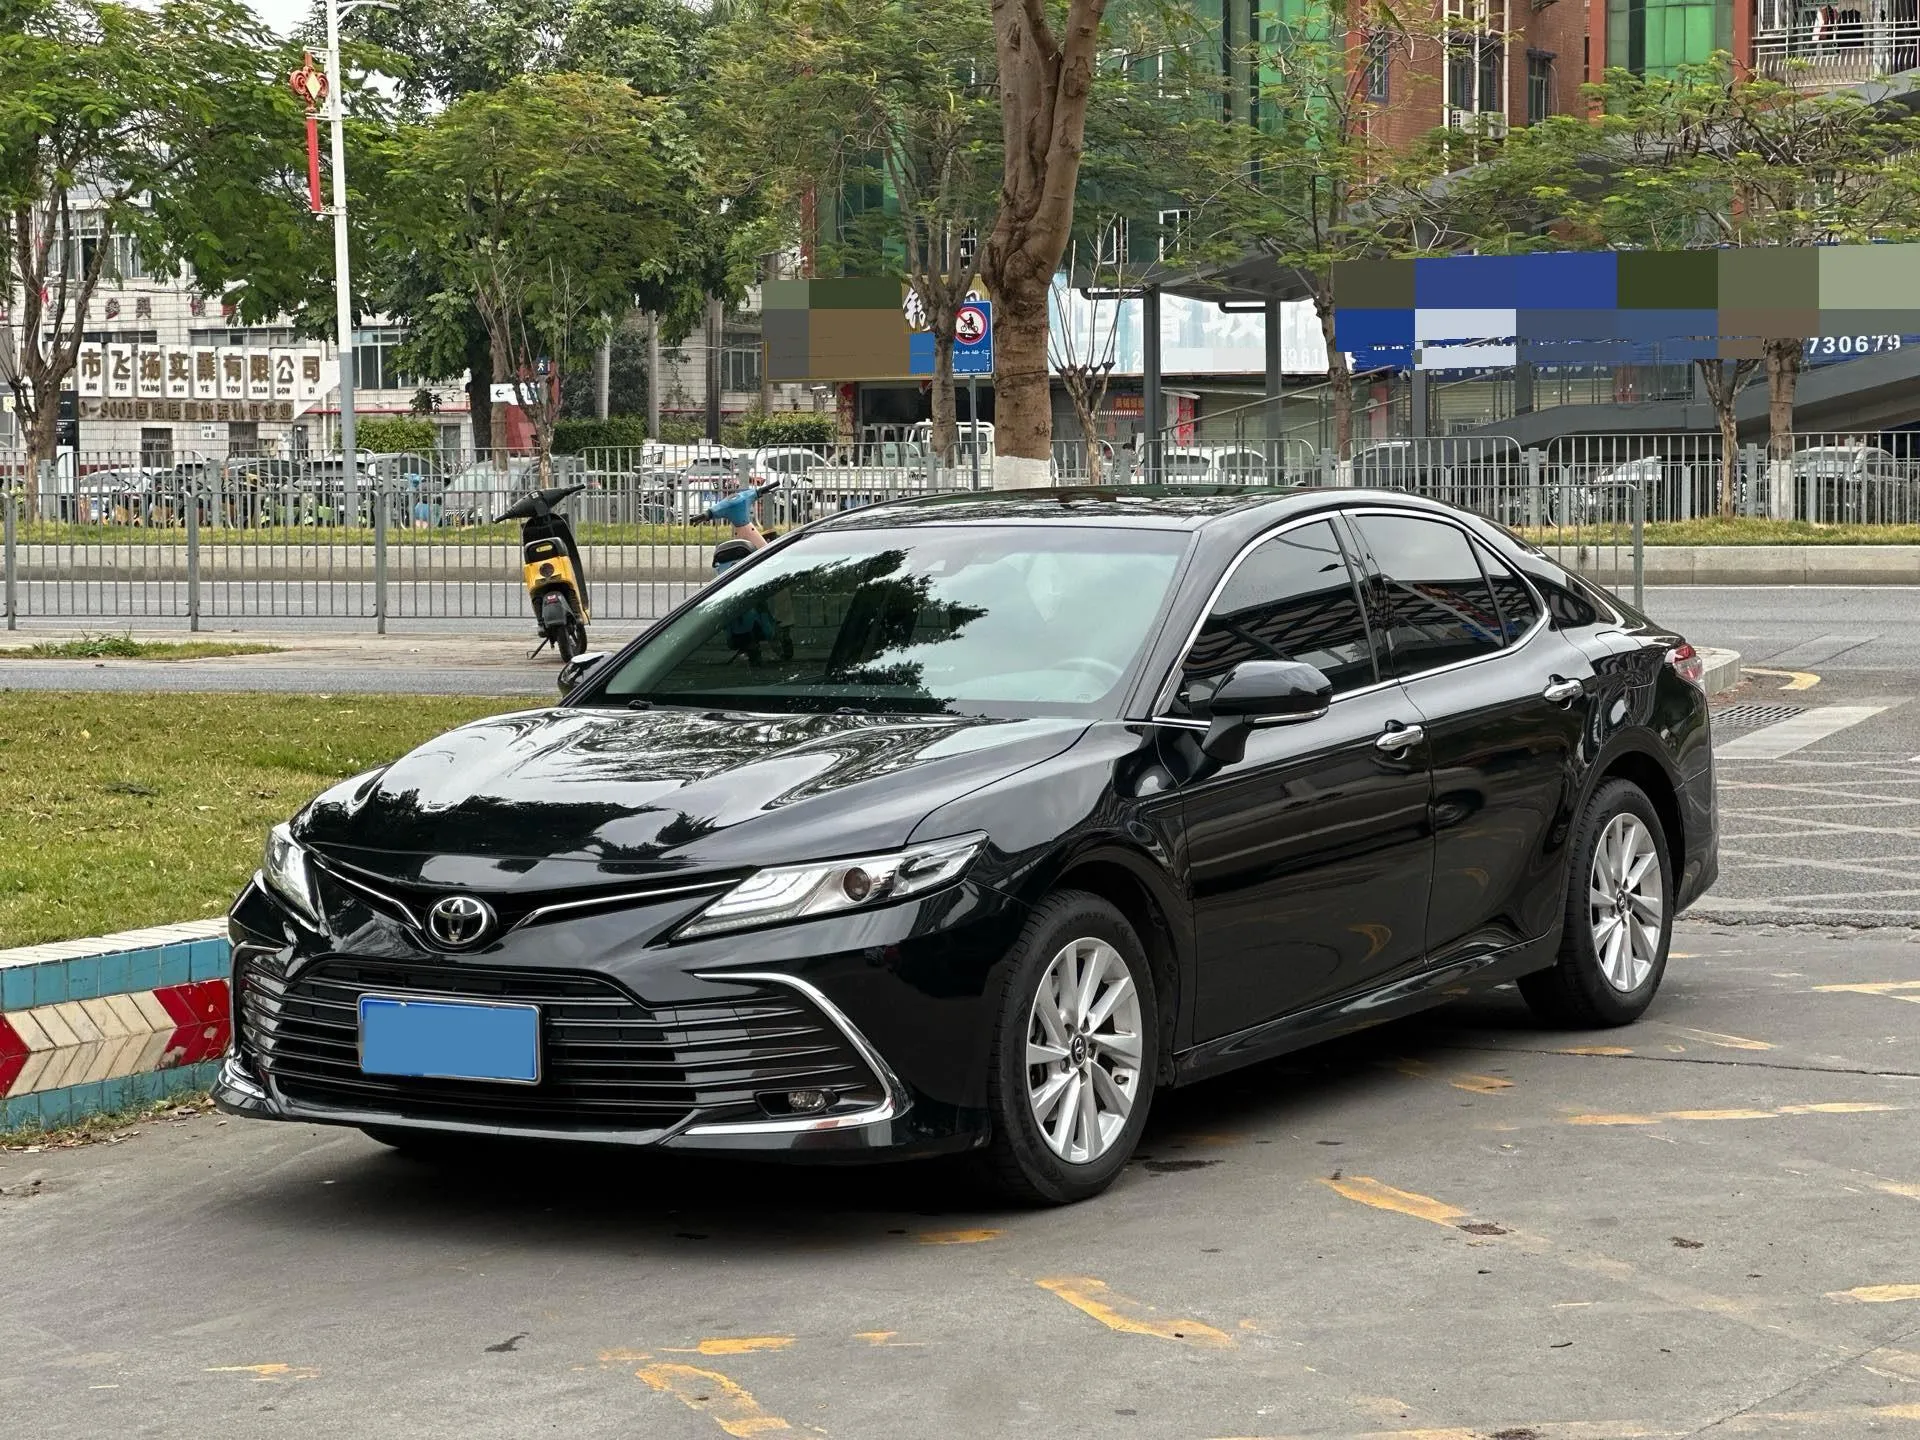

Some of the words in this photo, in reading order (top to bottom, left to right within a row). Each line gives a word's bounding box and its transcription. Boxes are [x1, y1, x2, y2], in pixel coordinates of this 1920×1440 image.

[86, 382, 98, 391] SHI
[115, 382, 127, 391] FEI
[141, 384, 160, 393] YANG
[172, 384, 185, 393] SHI
[200, 384, 210, 393] YE
[252, 386, 268, 394] XIAN
